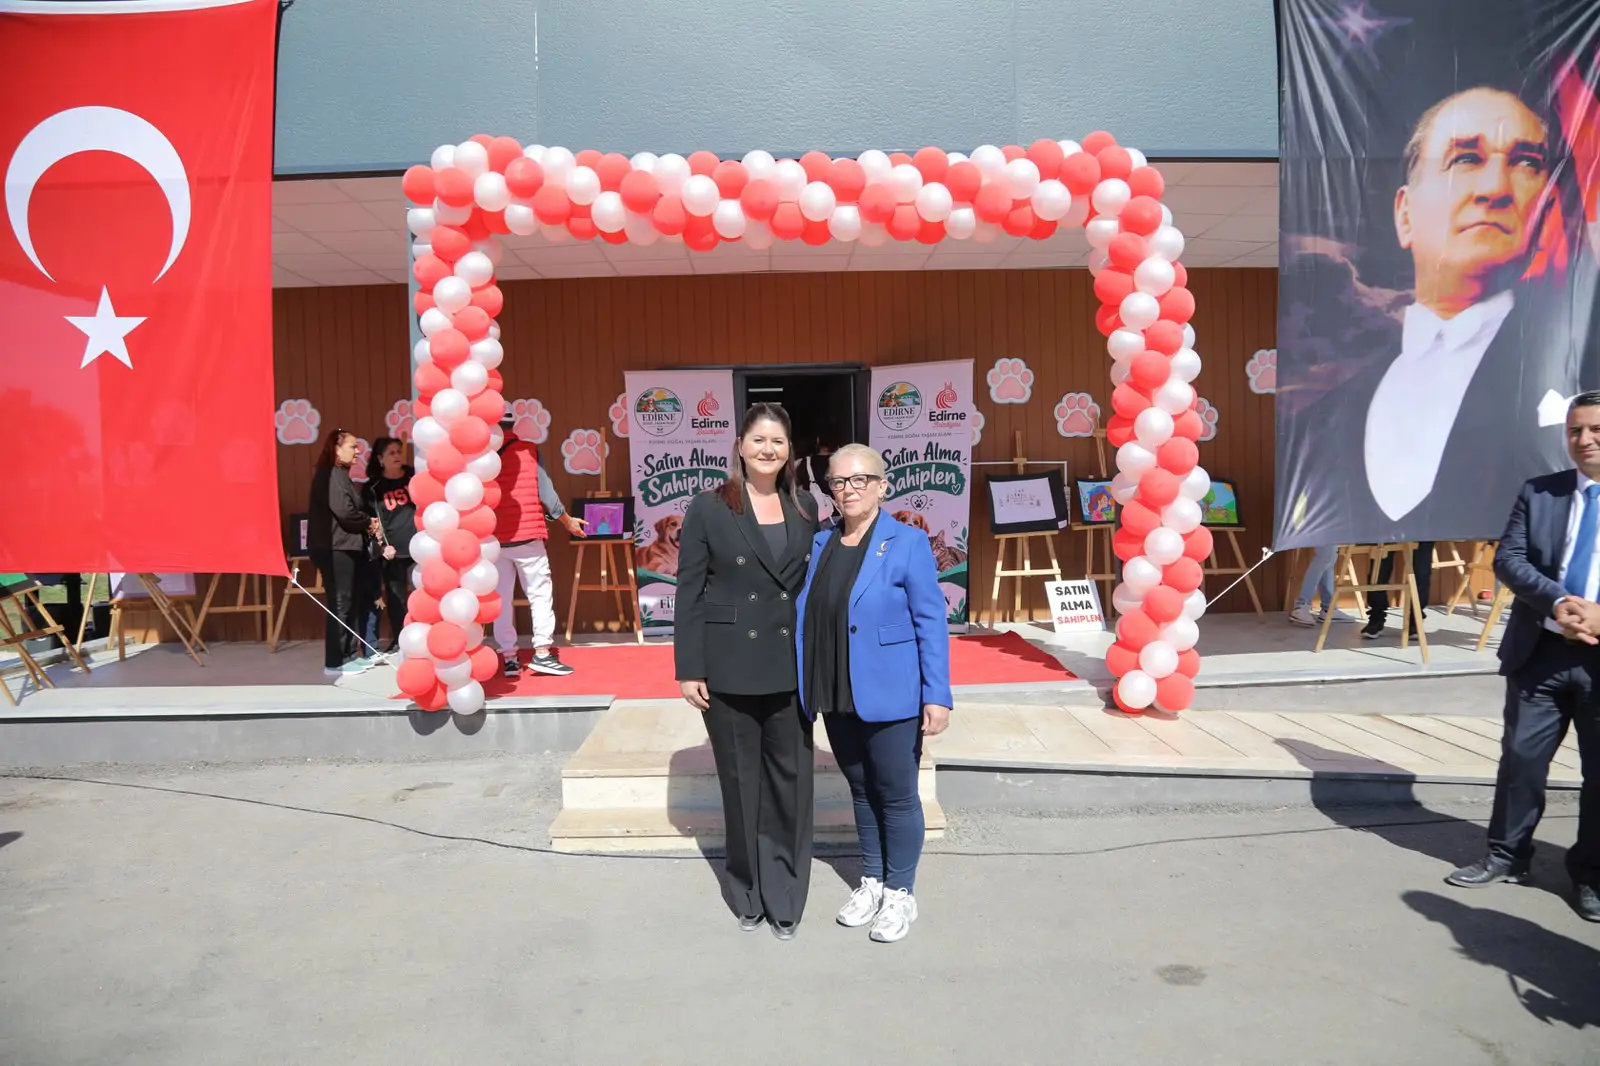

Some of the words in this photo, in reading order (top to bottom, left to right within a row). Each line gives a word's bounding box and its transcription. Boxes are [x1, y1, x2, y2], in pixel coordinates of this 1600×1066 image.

[642, 412, 676, 422] EDİRNE
[883, 407, 915, 416] EDİRNE
[929, 410, 967, 422] Edirne
[691, 418, 729, 429] Edirne
[644, 452, 684, 477] Satın
[689, 447, 728, 468] Alma
[882, 447, 919, 471] Satın
[923, 441, 961, 462] Alma
[648, 469, 725, 503] Sahiplen
[885, 464, 957, 498] Sahiplen
[384, 485, 409, 511] US
[1055, 585, 1090, 596] SATIN
[1060, 600, 1093, 611] ALMA
